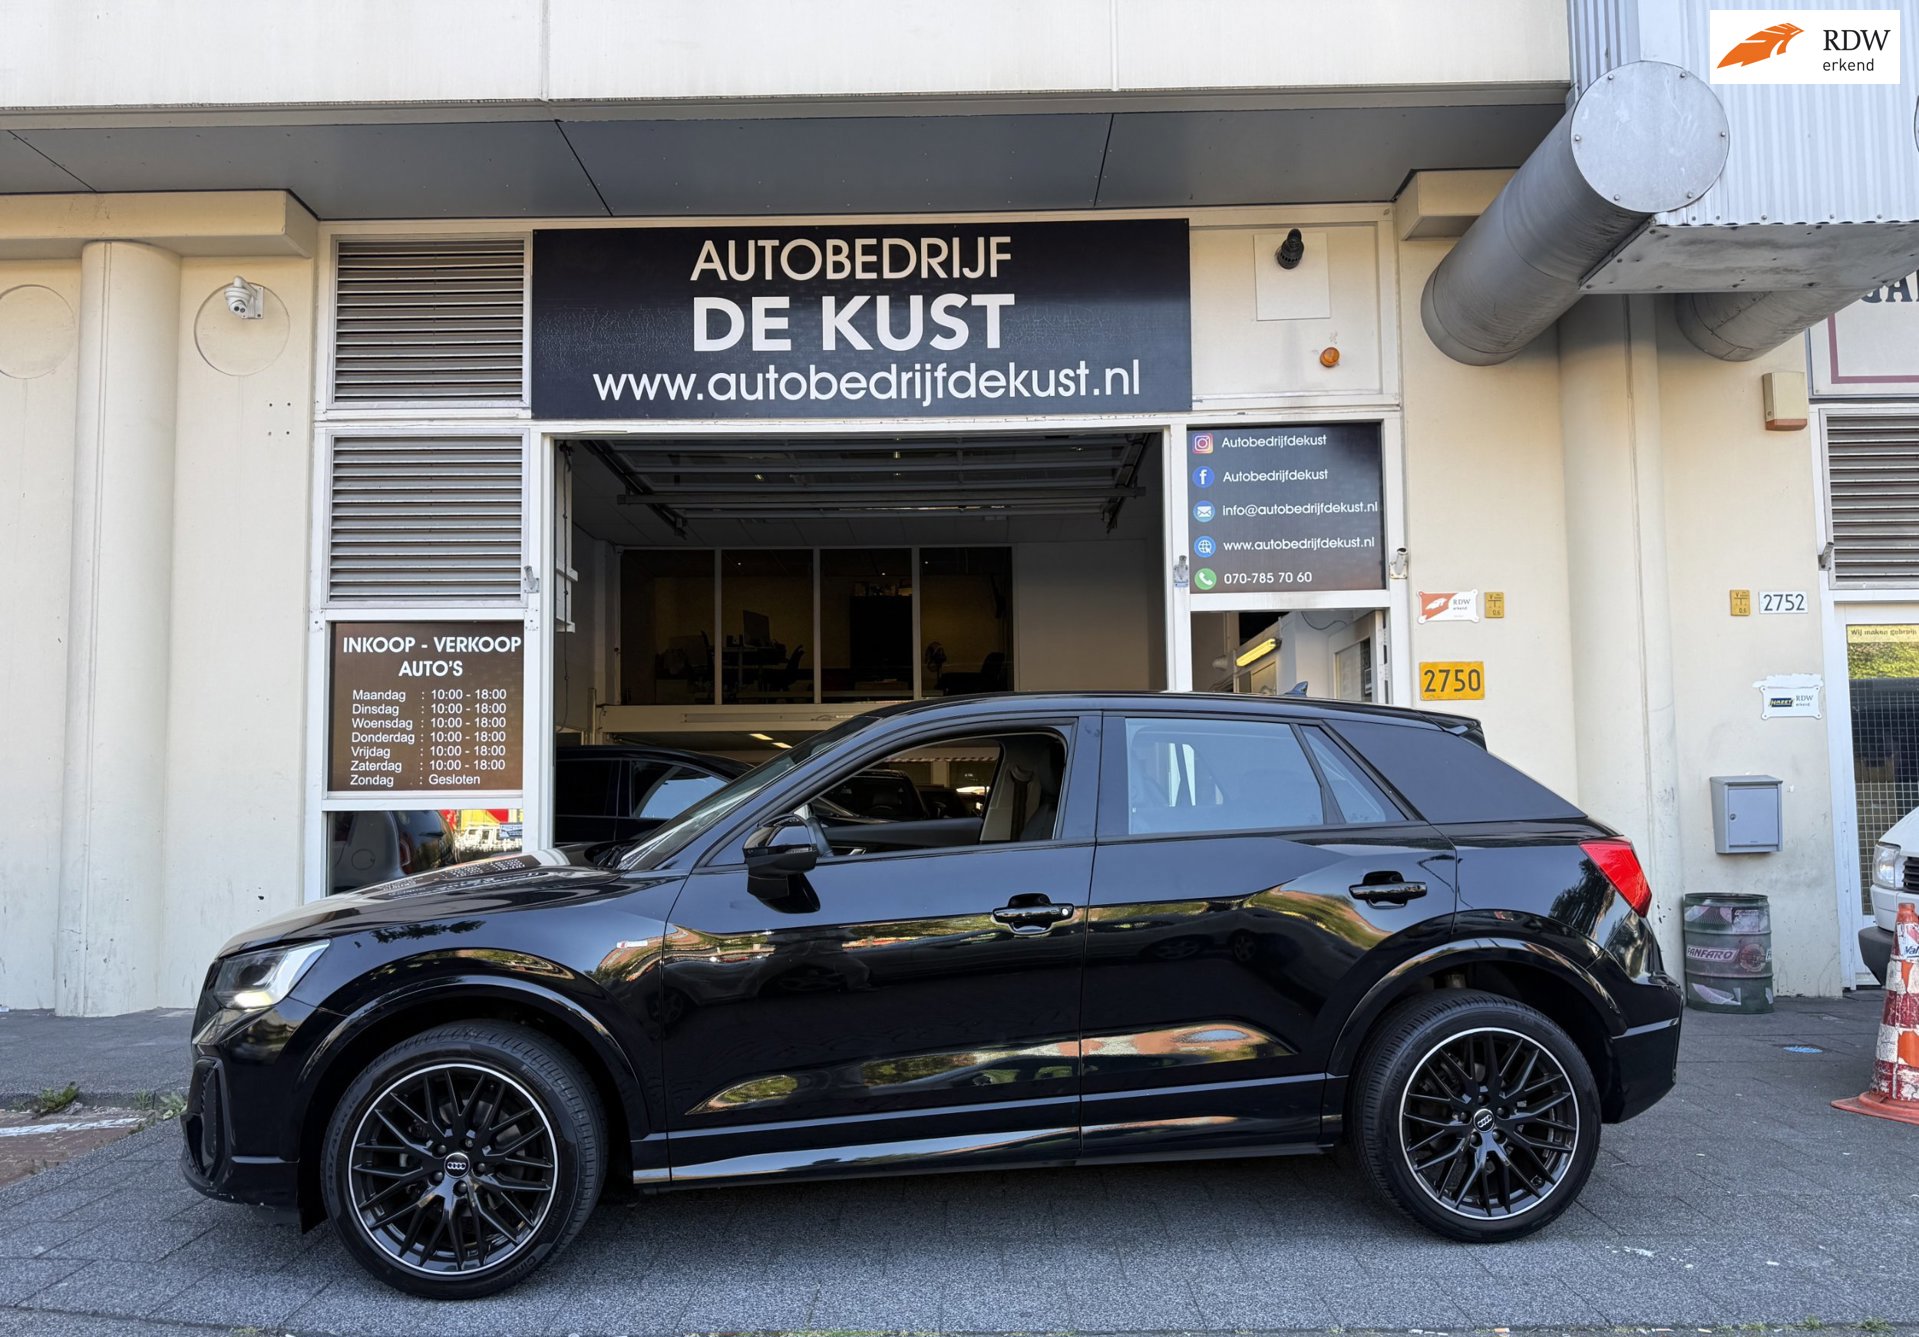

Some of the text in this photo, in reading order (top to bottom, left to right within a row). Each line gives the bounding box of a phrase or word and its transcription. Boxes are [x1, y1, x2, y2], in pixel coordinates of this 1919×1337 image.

[690, 236, 1012, 281] AUTOBEDRIJF
[693, 293, 1015, 352] DE KUST
[592, 359, 1141, 407] www.autobedrijfdekust.nl
[1221, 434, 1328, 449] Autobedrijfdekust
[1222, 468, 1329, 484] Autobedrijfdekust
[1222, 501, 1378, 518] info@autobedrijfdekust.nl
[1222, 536, 1375, 552] www.autobedrijfdekust.nl
[1223, 571, 1313, 585] 070-785 70 60
[1763, 593, 1806, 612] 2752
[343, 636, 416, 653] INKOOP
[433, 636, 522, 653] VERKOOP
[398, 660, 463, 677] AUTO'S
[1424, 668, 1481, 693] 2750
[352, 689, 407, 703] Maandag
[431, 688, 463, 700] 10:00
[474, 688, 507, 700] 18:00
[1795, 694, 1814, 702] RDW
[352, 703, 400, 717] Dinsdag
[430, 702, 463, 714] 10:00
[474, 702, 507, 714] 18:00
[351, 717, 413, 731] Woensdag
[429, 717, 463, 729] 10:00
[474, 717, 507, 729] 18:00
[351, 731, 416, 745] Donderdag
[429, 731, 463, 743] 10:00
[474, 731, 507, 743] 18:00
[350, 745, 391, 759] Vrijdag
[428, 745, 463, 757] 10:00
[474, 745, 507, 757] 18:00
[350, 759, 403, 774] Zaterdag
[428, 759, 463, 771] 10:00
[474, 759, 507, 771] 18:00
[349, 774, 394, 788] Zondag
[428, 773, 481, 785] Gesloten
